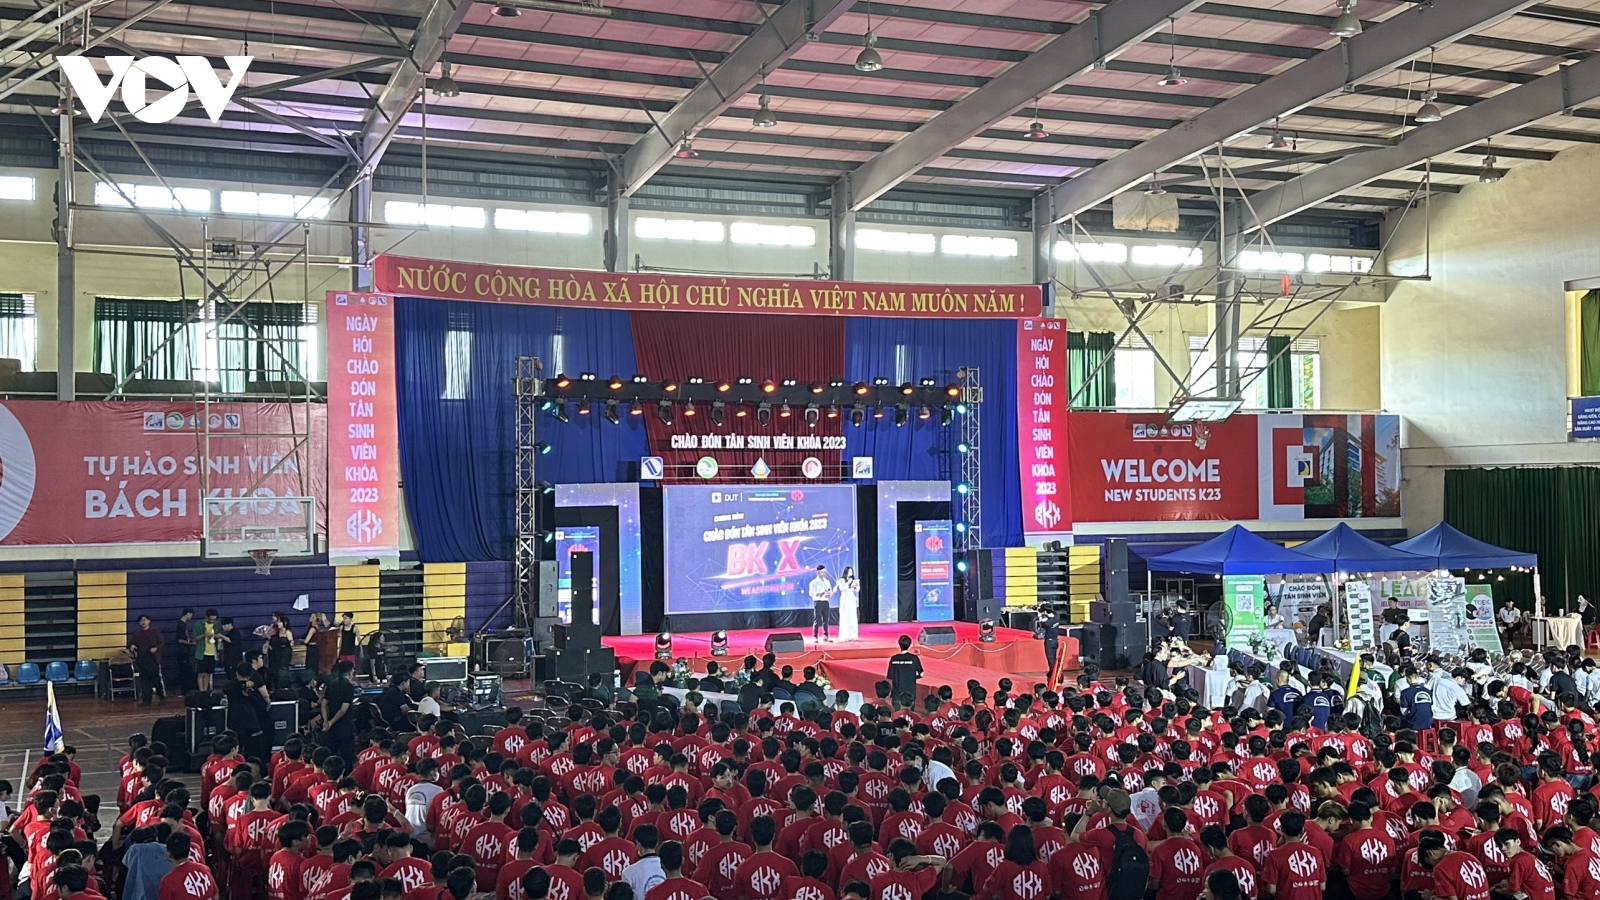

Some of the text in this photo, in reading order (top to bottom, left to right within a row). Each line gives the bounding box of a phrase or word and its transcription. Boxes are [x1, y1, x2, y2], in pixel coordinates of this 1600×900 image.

[397, 263, 467, 294] NƯỚC
[475, 269, 541, 302] CỘNG
[548, 274, 597, 302] HÒA
[603, 278, 632, 304] XÃ
[639, 278, 679, 309] HỘI
[686, 278, 730, 306] CHỦ
[737, 283, 804, 309] NGHĨA
[809, 285, 856, 315] VIỆT
[862, 291, 906, 311] NAM
[911, 288, 968, 313] MUÔN
[973, 289, 1015, 313] NĂM
[346, 314, 378, 332] NGÀY
[1031, 336, 1054, 352] NGÀY
[347, 355, 379, 375] CHÀO
[351, 380, 376, 396] ĐÓN
[1031, 371, 1054, 388] CHÀO
[1033, 392, 1052, 405] ĐÓN
[349, 400, 373, 418] TÂN
[1033, 410, 1050, 423] TÂN
[348, 424, 374, 439] SINH
[671, 433, 847, 450] CHÀO ĐÓN TÂN SINH VIÊN KHÓA 2023
[1032, 428, 1051, 441] SINH
[351, 442, 377, 460] VIÊN
[1035, 443, 1054, 459] VIÊN
[84, 450, 299, 481] TỰ HÀO SINH VIÊN
[345, 465, 378, 482] KHÓA
[1031, 462, 1055, 477] KHÓA
[1101, 459, 1220, 483] WELCOME
[350, 487, 379, 503] 2023
[1035, 482, 1056, 495] 2023
[1104, 487, 1221, 502] NEW STUDENTS K23
[85, 481, 300, 519] BÁCH KHOA
[1035, 500, 1061, 529] BKX
[346, 509, 382, 543] BKX
[703, 528, 724, 542] CHÀO
[725, 526, 740, 540] ĐÓN
[741, 524, 755, 538] TÂN
[755, 523, 772, 536] SINH
[774, 520, 789, 534] VIÊN
[809, 518, 828, 530] 2023
[727, 540, 800, 576] BK X
[1289, 584, 1305, 592] CHÀO
[1020, 725, 1038, 741] BKX
[1504, 723, 1523, 740] BKX
[504, 735, 524, 753] BKX
[627, 754, 649, 774] BKX
[1073, 758, 1096, 776] BKX
[1253, 762, 1277, 781] BKX
[865, 778, 888, 799] BKX
[1123, 772, 1145, 792] BKX
[1409, 770, 1429, 791] BKX
[1194, 795, 1218, 818] BKX
[1291, 790, 1310, 811] BKX
[670, 812, 696, 836] BKX
[475, 833, 501, 859] BKX
[933, 833, 960, 858] BKX
[1361, 838, 1388, 864] BKX
[603, 850, 630, 877] BKX
[1072, 852, 1100, 880] BKX
[1173, 848, 1200, 875] BKX
[1288, 850, 1317, 878] BKX
[184, 870, 211, 896] BKX
[751, 866, 781, 895] BKX
[1013, 870, 1042, 899] BKX
[1460, 861, 1487, 889] BKX
